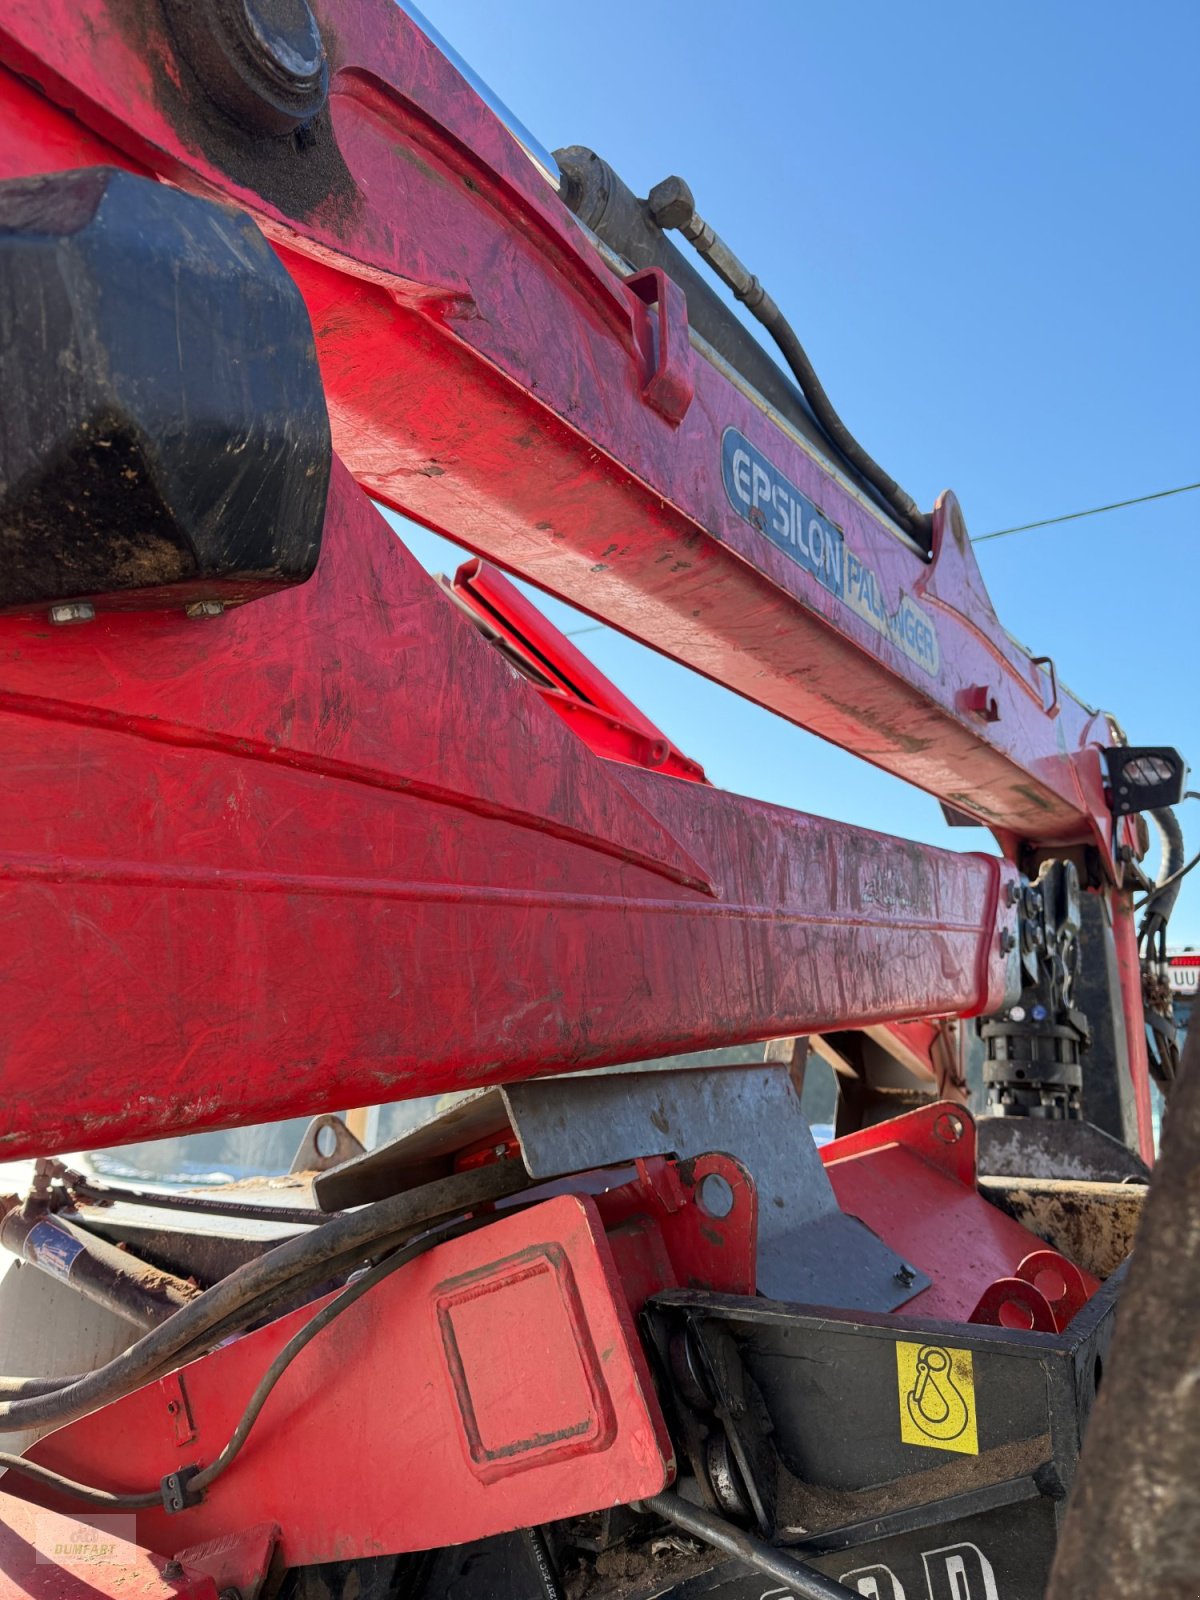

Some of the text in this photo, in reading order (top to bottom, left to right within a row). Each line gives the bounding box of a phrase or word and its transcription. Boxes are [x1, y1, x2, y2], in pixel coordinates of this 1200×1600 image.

[732, 448, 936, 666] EPSILON PALNGER
[1174, 970, 1196, 986] UU
[546, 1584, 558, 1600] 237
